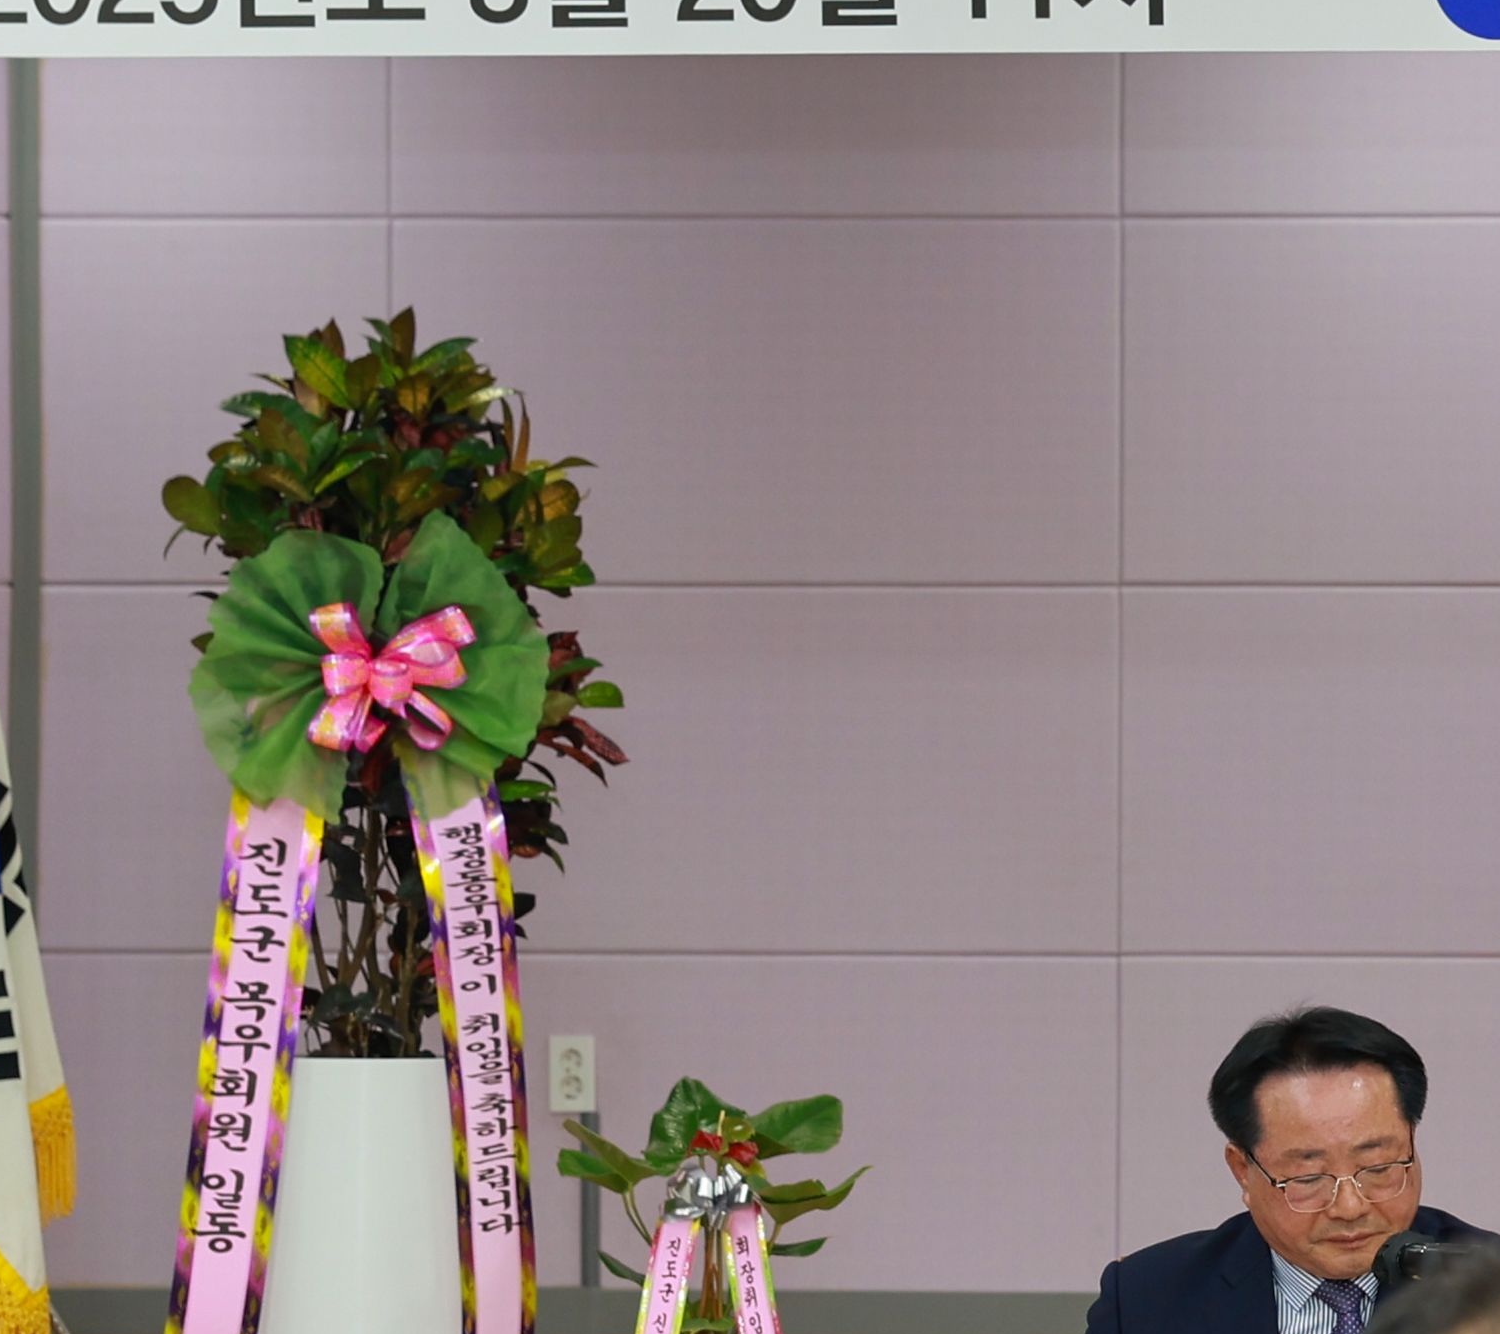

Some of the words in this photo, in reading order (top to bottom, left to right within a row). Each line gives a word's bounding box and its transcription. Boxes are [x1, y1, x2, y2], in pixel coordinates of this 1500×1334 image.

[231, 837, 289, 964] 진도군
[439, 822, 505, 966] 행정동우회장
[460, 973, 498, 996] 이
[207, 981, 277, 1152] 목우회원
[461, 1012, 512, 1085] 취임을
[192, 1167, 247, 1254] 일동
[470, 1092, 526, 1235] 축하드립니다
[659, 1237, 682, 1304] 진도군
